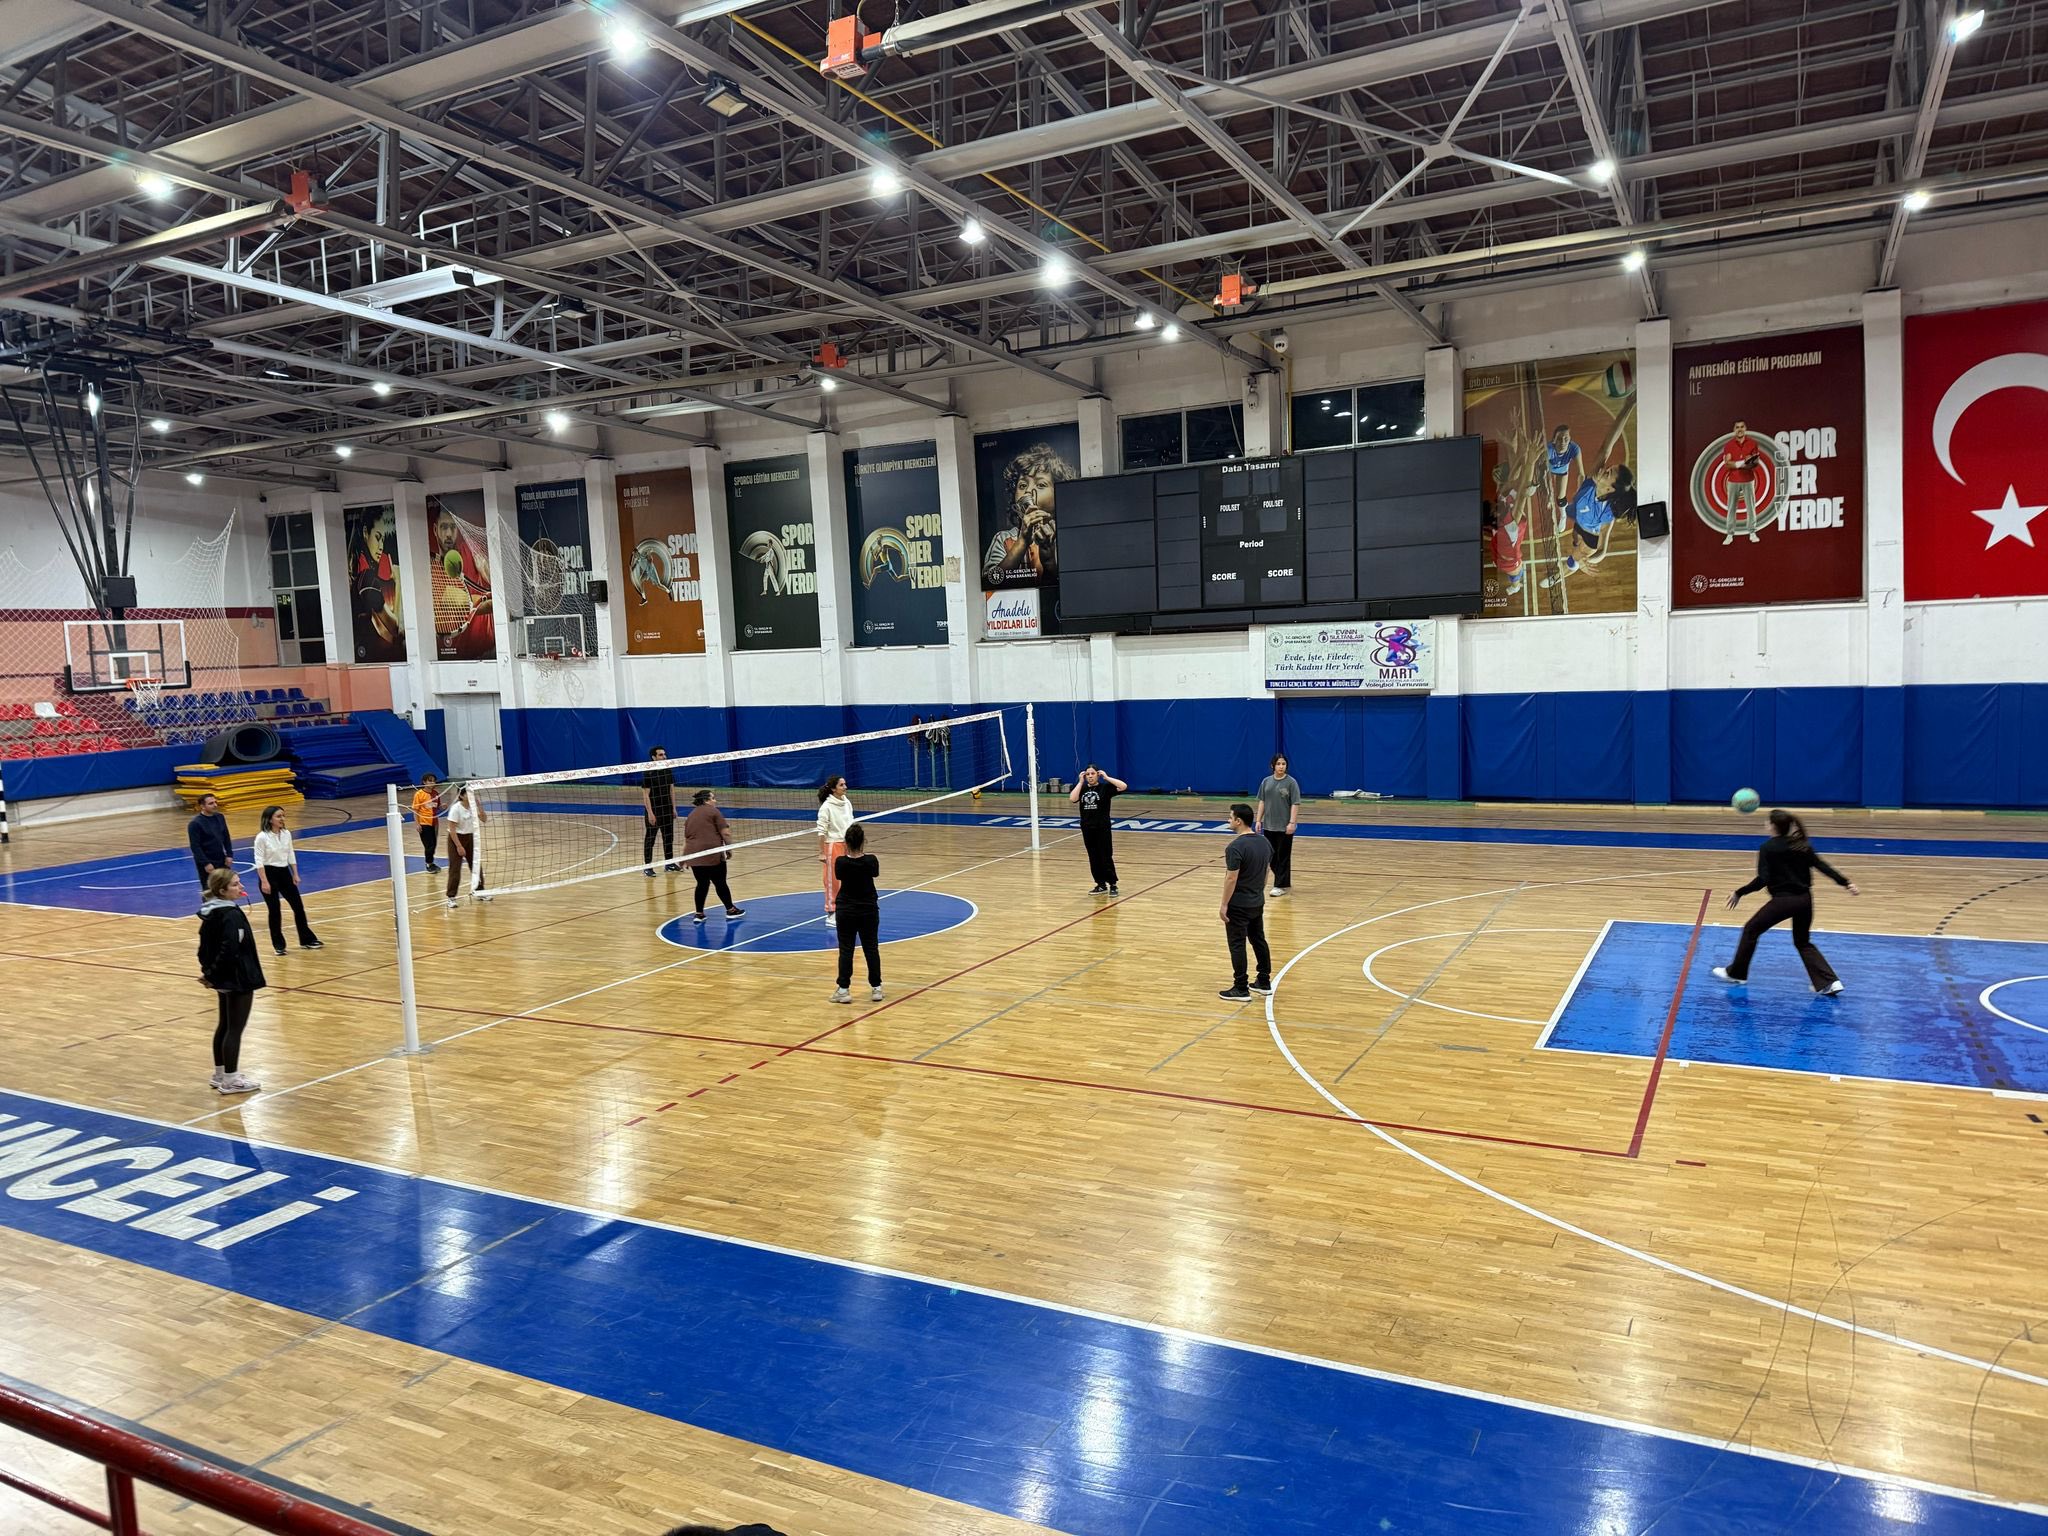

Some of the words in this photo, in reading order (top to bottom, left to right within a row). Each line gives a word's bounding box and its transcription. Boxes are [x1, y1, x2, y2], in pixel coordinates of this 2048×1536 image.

[1689, 360, 1735, 379] ANTRENÖR
[1738, 355, 1769, 372] EĞİTİM
[1771, 351, 1822, 369] PROGRAMI
[1689, 381, 1702, 395] İLE
[1774, 427, 1837, 462] SPOR
[854, 462, 876, 475] TÜRKİYE
[876, 460, 903, 472] OLİMPİYAT
[904, 455, 936, 469] MERKEZLERİ
[1222, 465, 1242, 473] Data
[1244, 462, 1280, 471] Tasarım
[734, 475, 753, 486] SPORCU
[770, 468, 799, 482] MERKEZLERİ
[1774, 464, 1817, 496] HER
[1774, 496, 1844, 531] YERDE
[781, 523, 814, 547] SPOR
[905, 514, 942, 539] SPOR
[668, 533, 698, 556] SPOR
[1240, 540, 1263, 548] Period
[558, 545, 583, 569] SPOR
[1212, 572, 1236, 581] SCORE
[1268, 569, 1293, 577] SCORE
[992, 600, 1031, 618] Anadolu
[987, 619, 1023, 630] YILDIZLARI
[1025, 617, 1038, 628] LİGİ
[1284, 653, 1305, 661] Evde,
[1308, 652, 1324, 662] İşte,
[1327, 653, 1354, 661] Filede;
[1275, 663, 1293, 671] Türk
[1296, 663, 1323, 671] Kadını
[1343, 662, 1364, 670] Yerde
[1379, 668, 1413, 679] MART
